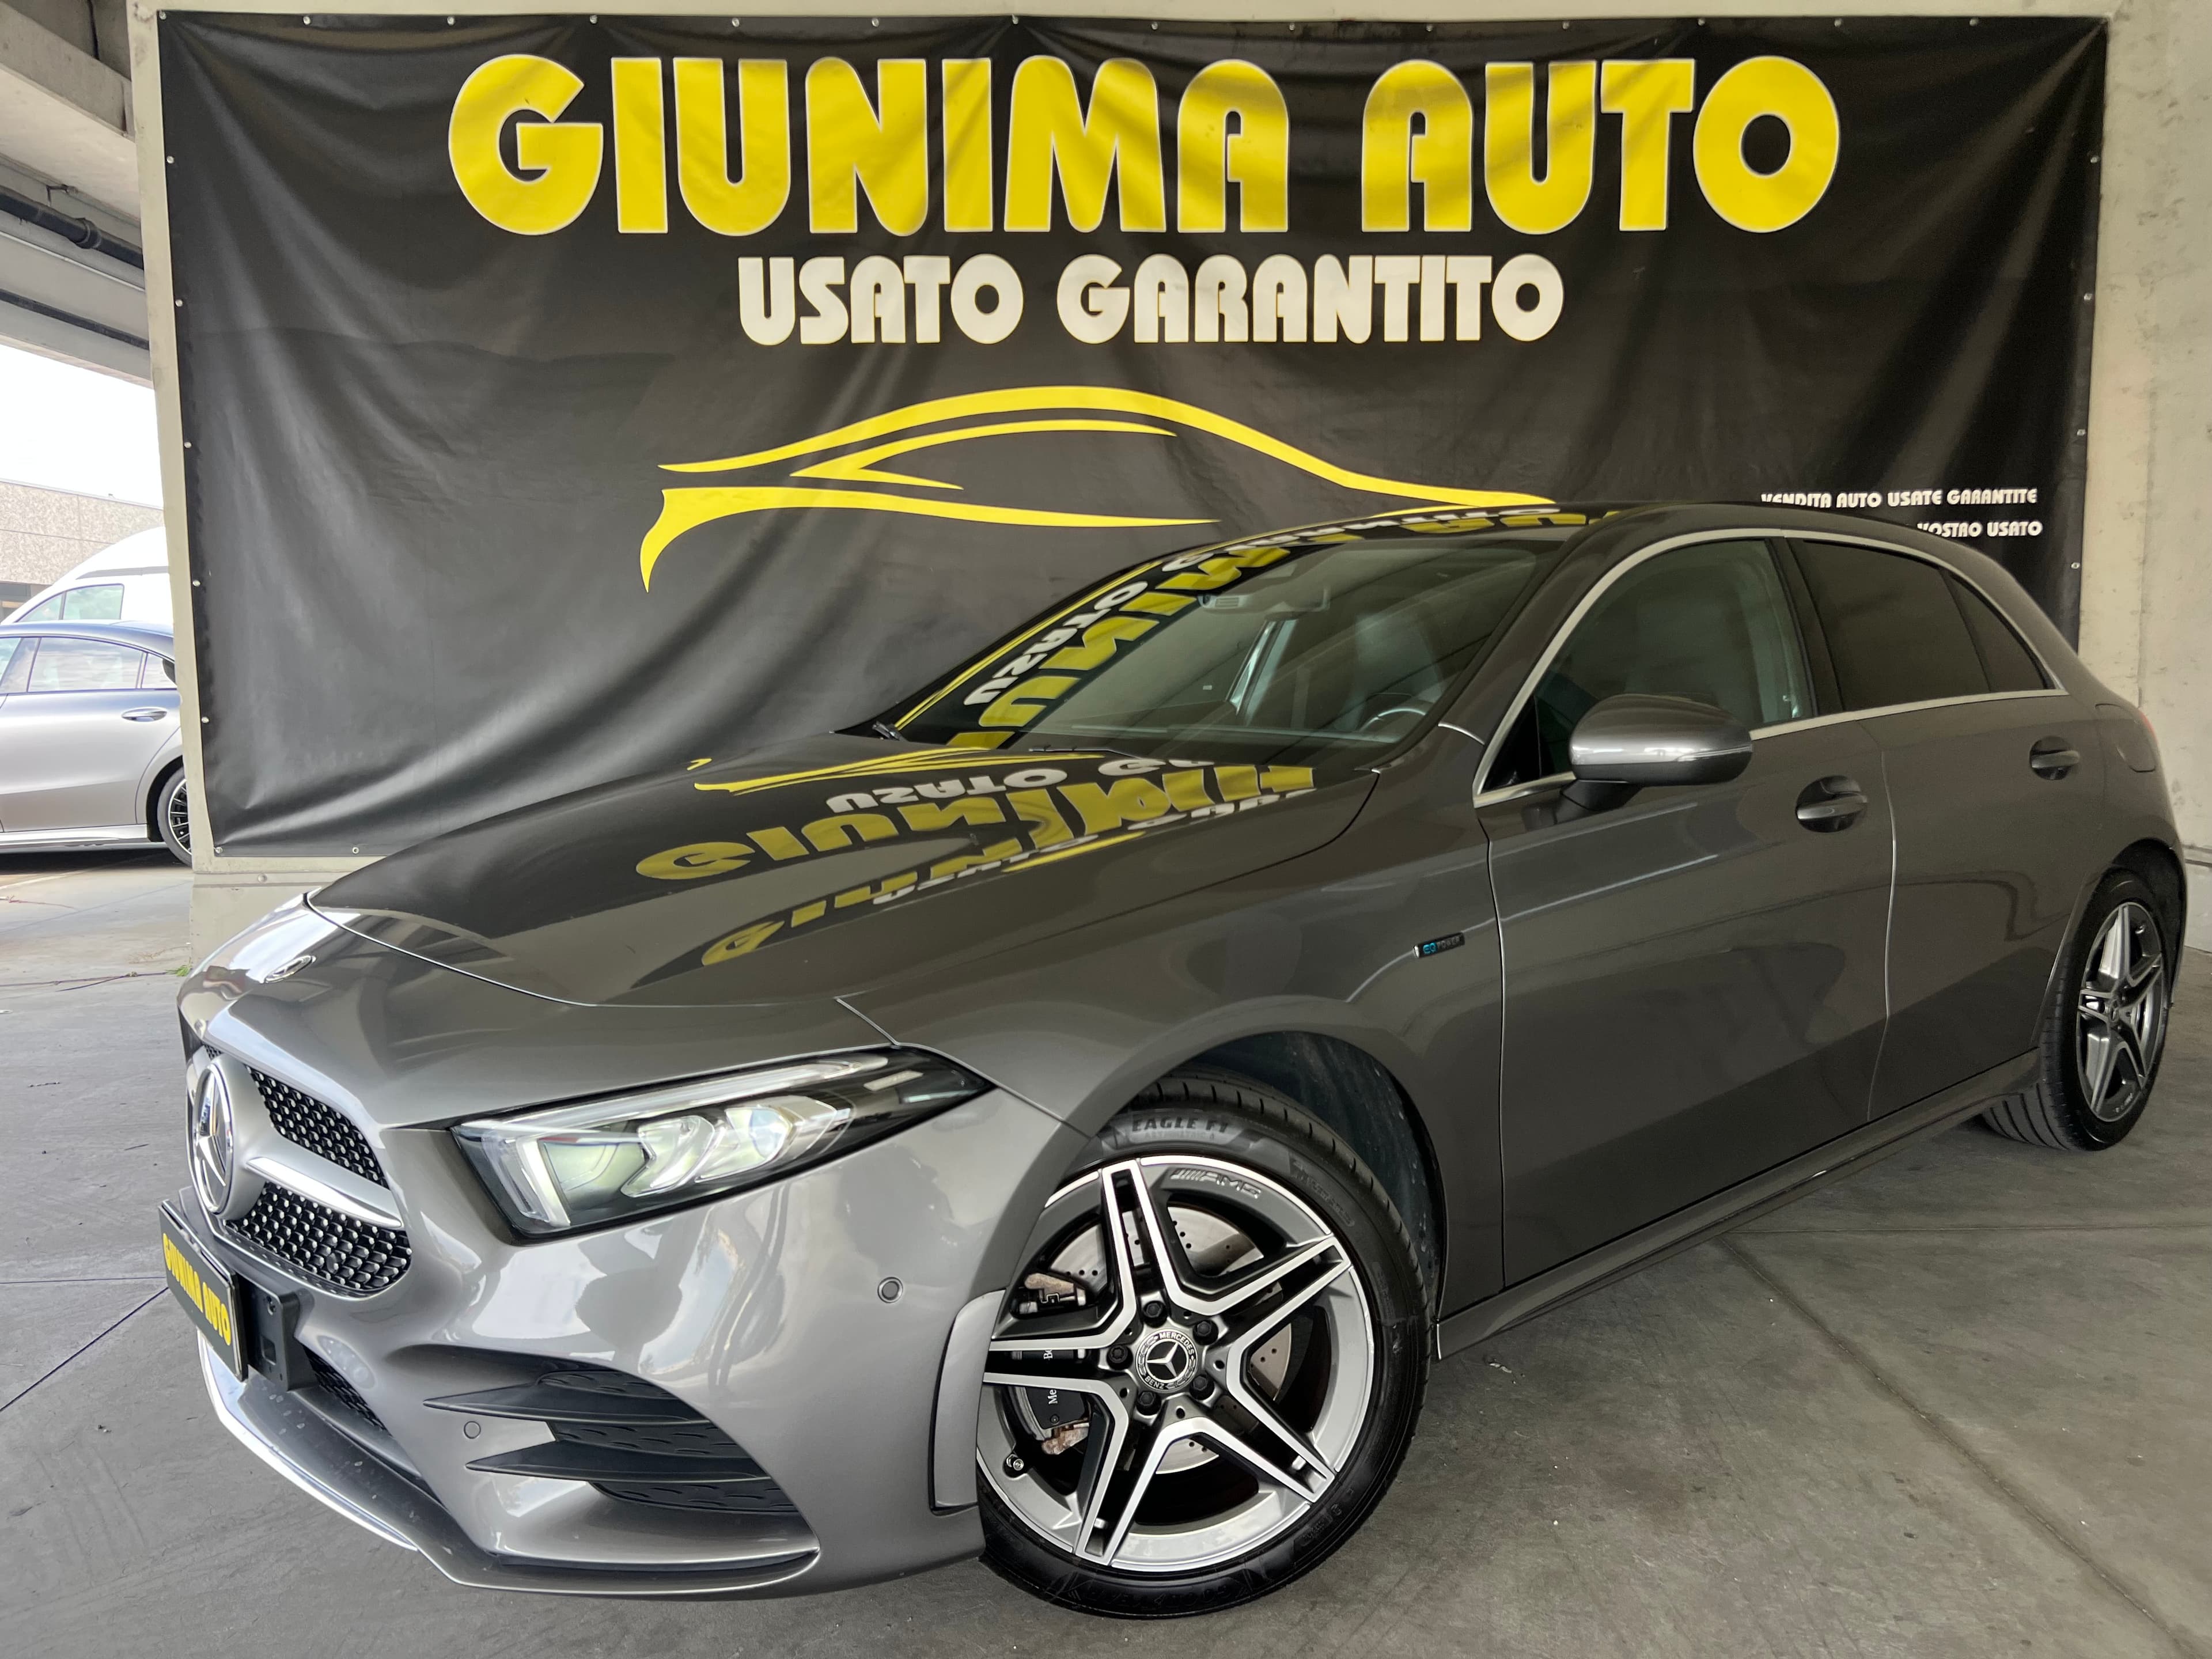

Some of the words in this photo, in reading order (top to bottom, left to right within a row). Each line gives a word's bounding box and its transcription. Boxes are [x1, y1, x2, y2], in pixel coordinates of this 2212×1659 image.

[448, 54, 1290, 236] GIUNIMA
[1361, 55, 1840, 234] AUTO
[738, 255, 1022, 343] USATO
[1058, 255, 1563, 341] GARANTITO
[1836, 492, 1882, 507] AUTO
[1888, 490, 1942, 507] USATE
[1947, 488, 2037, 505] GARANTITE
[1987, 521, 2043, 536] USATO
[1132, 1114, 1199, 1132] EAGLE
[203, 1281, 232, 1346] AUTO
[1159, 1331, 1195, 1355] MERCEDES
[1144, 1374, 1165, 1390] BENZ
